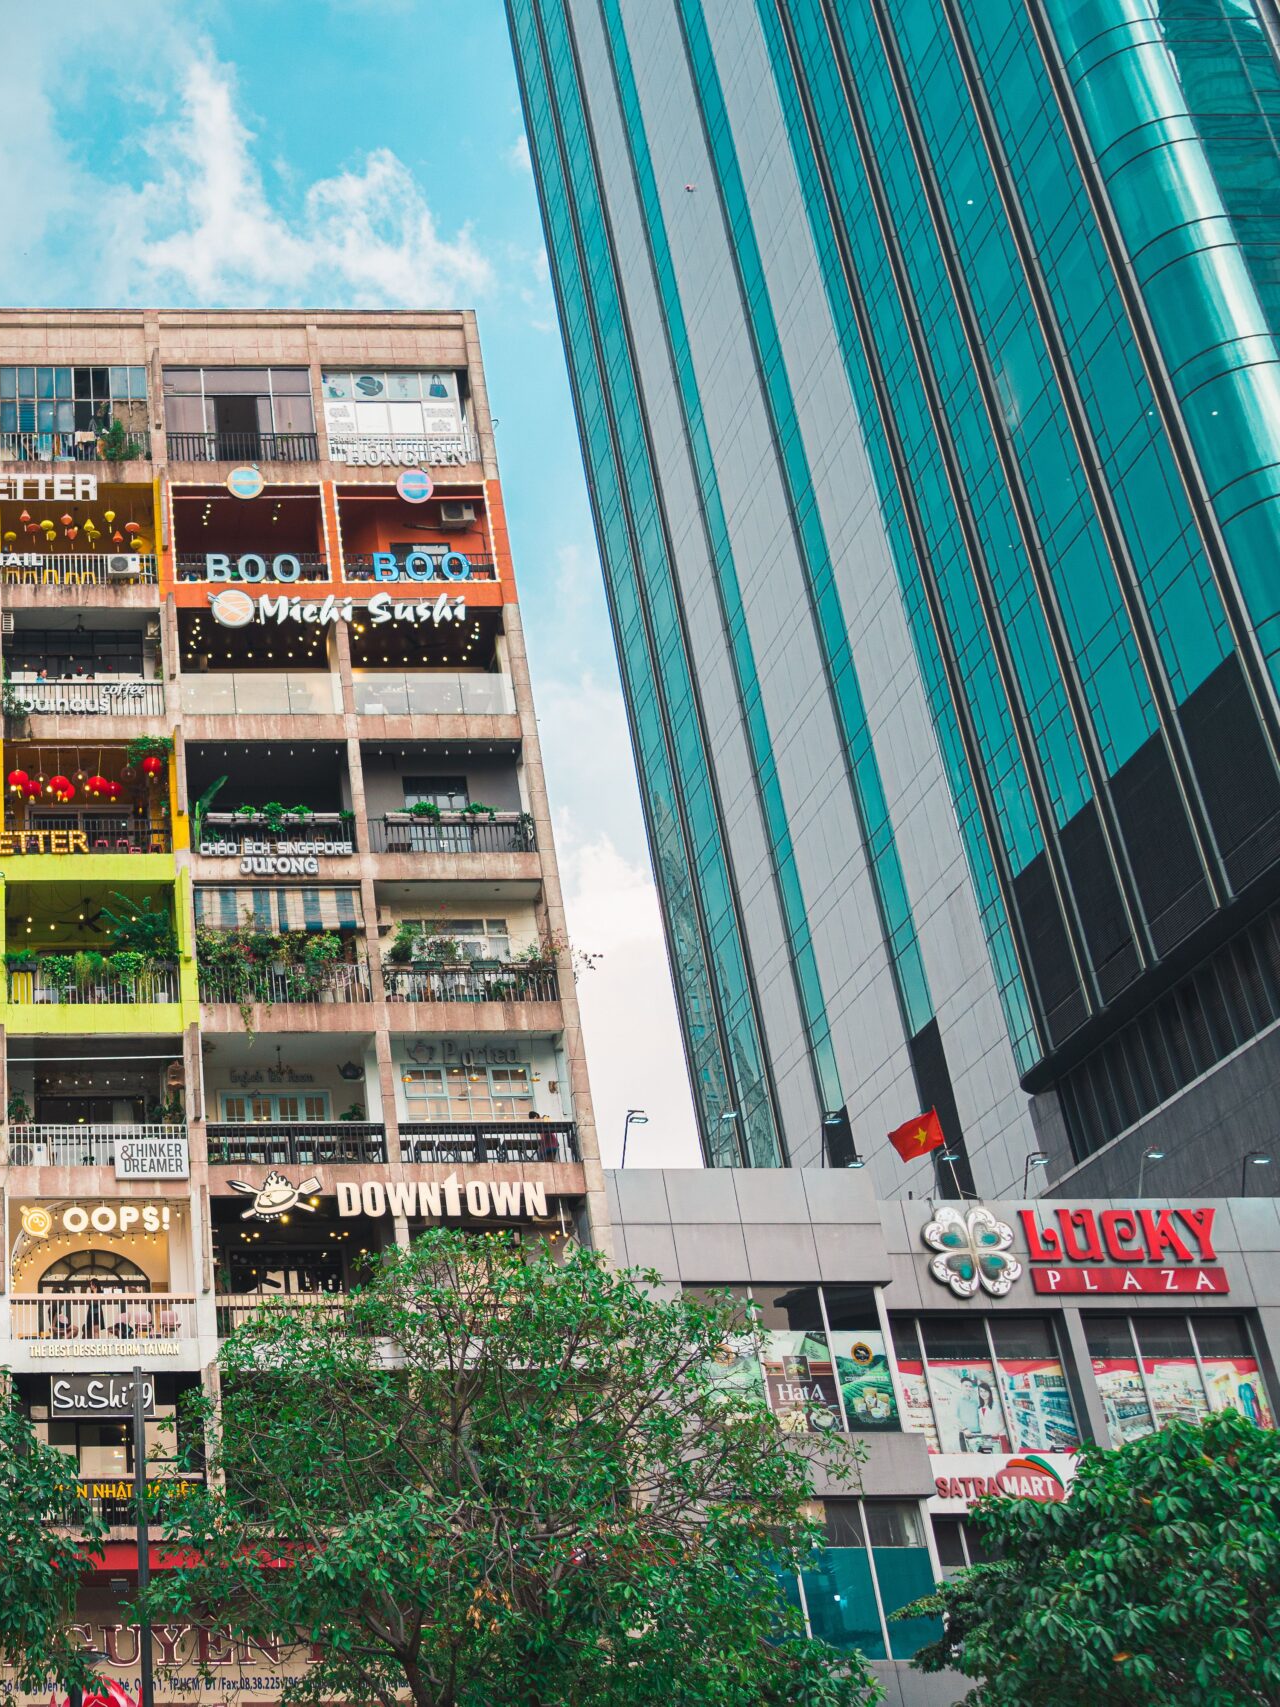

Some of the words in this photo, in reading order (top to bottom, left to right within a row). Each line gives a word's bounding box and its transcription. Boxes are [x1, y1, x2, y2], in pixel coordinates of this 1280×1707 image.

[206, 553, 301, 583] BOO
[373, 551, 470, 582] BOO
[259, 594, 353, 625] Michi
[367, 592, 466, 624] Sushi
[102, 682, 146, 698] coffee
[200, 839, 237, 856] CHÁO
[277, 841, 353, 855] SINGAPORE
[128, 1143, 182, 1157] THINKER
[124, 1158, 183, 1173] DREAMER
[63, 1206, 170, 1232] OOPS!
[1046, 1270, 1216, 1290] PLAZA
[30, 1344, 47, 1357] THE
[48, 1344, 71, 1357] BEST
[73, 1343, 113, 1357] DESSERT
[115, 1343, 141, 1356] FORM
[143, 1343, 180, 1355] TAIWAN
